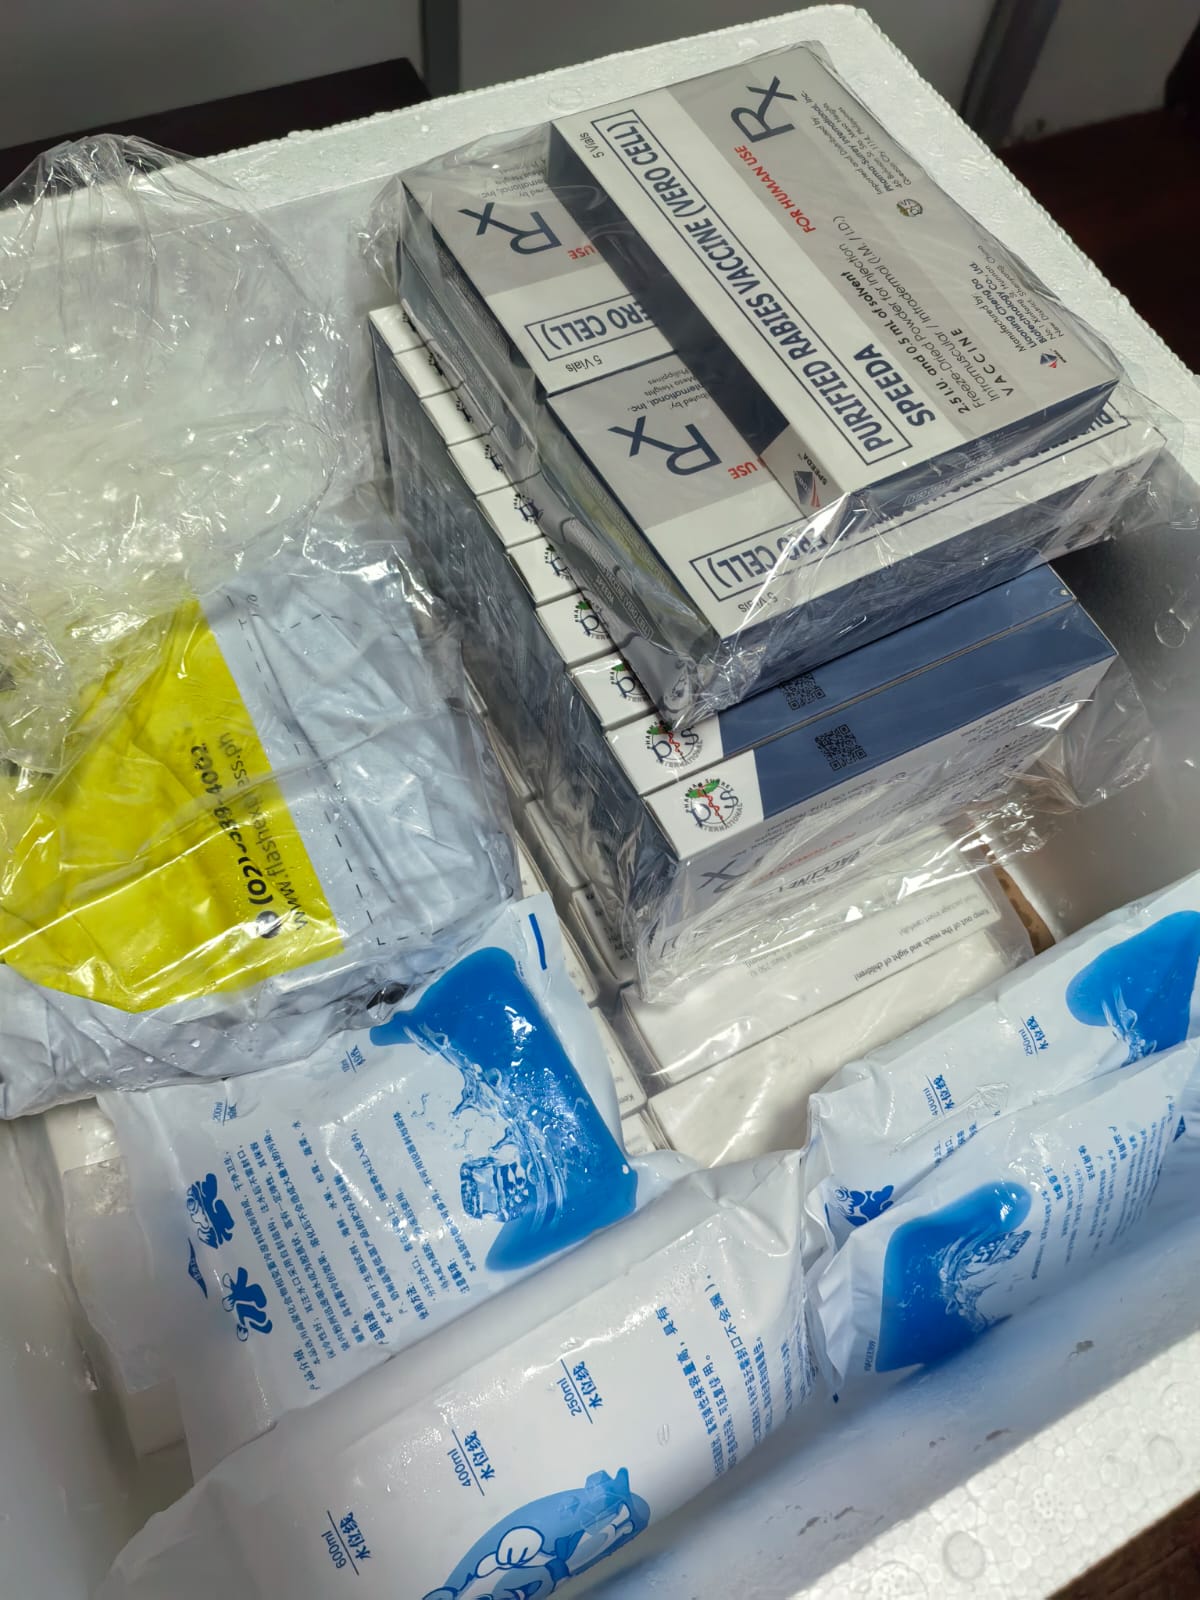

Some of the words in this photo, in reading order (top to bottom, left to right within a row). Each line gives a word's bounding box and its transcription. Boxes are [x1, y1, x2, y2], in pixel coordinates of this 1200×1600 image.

[580, 132, 599, 153] Vials
[607, 120, 658, 166] CELL)
[735, 146, 758, 166] USE
[849, 145, 894, 192] Pharma-Surrey
[645, 167, 707, 218] (VERO
[753, 166, 795, 210] HUMAN
[790, 209, 817, 233] FOR
[568, 242, 596, 260] USE
[686, 219, 760, 295] VACCINE
[839, 244, 879, 286] Injection
[841, 272, 878, 307] solvent
[875, 265, 931, 323] Intradermal
[875, 287, 892, 302] for
[971, 278, 984, 290] Da
[607, 298, 648, 330] ERO
[872, 308, 888, 319] of
[982, 290, 1007, 316] Cheng
[997, 292, 1048, 344] Biotechnology
[541, 305, 607, 350] CELL)
[746, 294, 817, 360] RABIES
[888, 303, 926, 342] Powder
[980, 305, 1027, 352] Manufactured
[1006, 316, 1038, 349] Liaoning
[593, 355, 603, 365] 5
[898, 337, 918, 354] 0.5
[951, 329, 1014, 396] VACCINE
[565, 359, 595, 373] Vials
[913, 355, 937, 376] and
[922, 342, 985, 409] Freeze-Dried
[935, 332, 1000, 402] Intramuscular
[650, 378, 707, 406] nternational,
[683, 389, 710, 407] ibuted
[855, 345, 935, 426] SPEEDA
[804, 361, 892, 451] PURIFIED
[949, 397, 971, 414] 2.5
[728, 462, 758, 480] USE
[803, 452, 828, 486] SPEEDA
[773, 522, 828, 565] ERO
[708, 546, 777, 588] CELL)
[767, 592, 779, 603] 5
[939, 924, 954, 937] the
[951, 920, 963, 932] of
[960, 914, 974, 926] out
[889, 945, 910, 963] sight
[907, 940, 924, 953] and
[921, 930, 942, 946] reach
[881, 956, 894, 968] of
[1019, 1029, 1034, 1057] 250ml
[934, 1075, 955, 1110] 水位线
[557, 1378, 582, 1417] 250ml
[573, 1362, 603, 1408] 水位线
[448, 1449, 472, 1487] 400ml
[465, 1431, 495, 1480] 水位线
[321, 1531, 347, 1569] 600ml
[340, 1513, 371, 1560] 水位线
